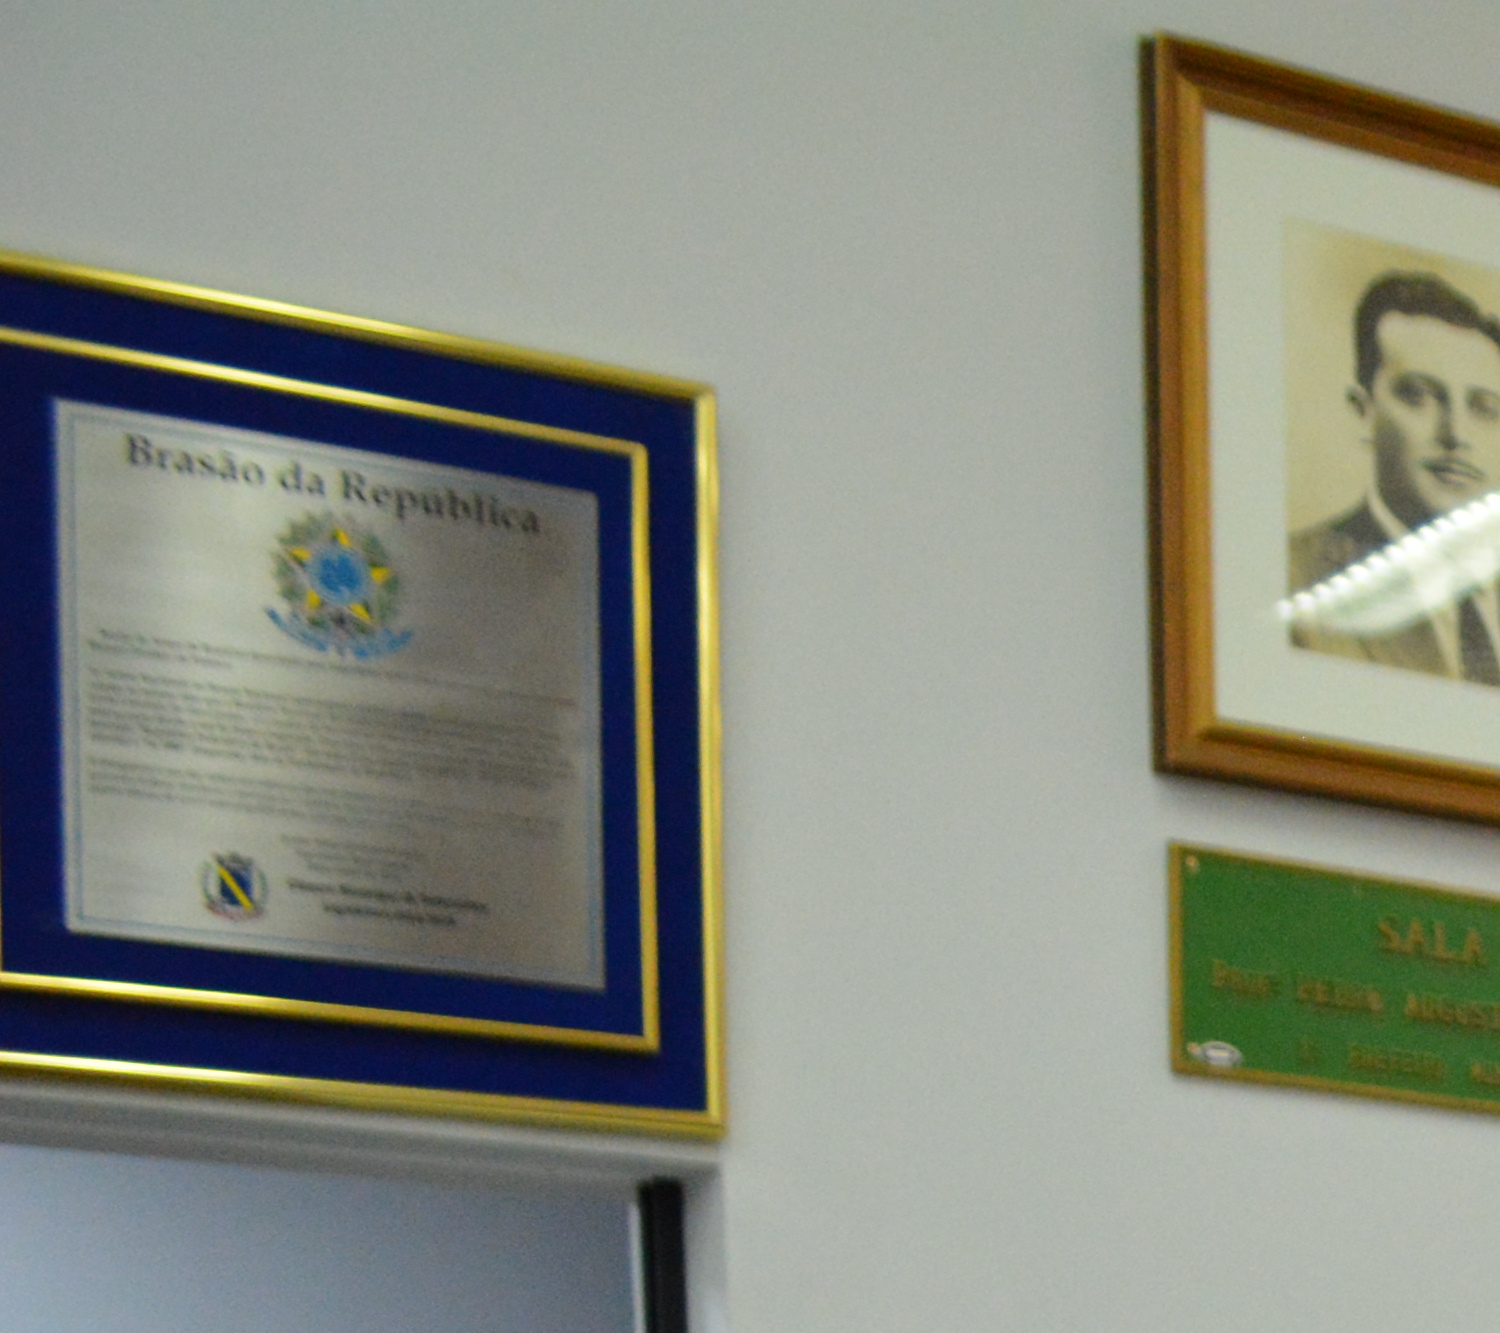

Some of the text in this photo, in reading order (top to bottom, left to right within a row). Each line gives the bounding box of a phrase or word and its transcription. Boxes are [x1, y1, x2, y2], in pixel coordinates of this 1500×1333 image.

[123, 431, 265, 489] Brasão
[276, 460, 327, 498] da
[1377, 914, 1487, 967] SALA
